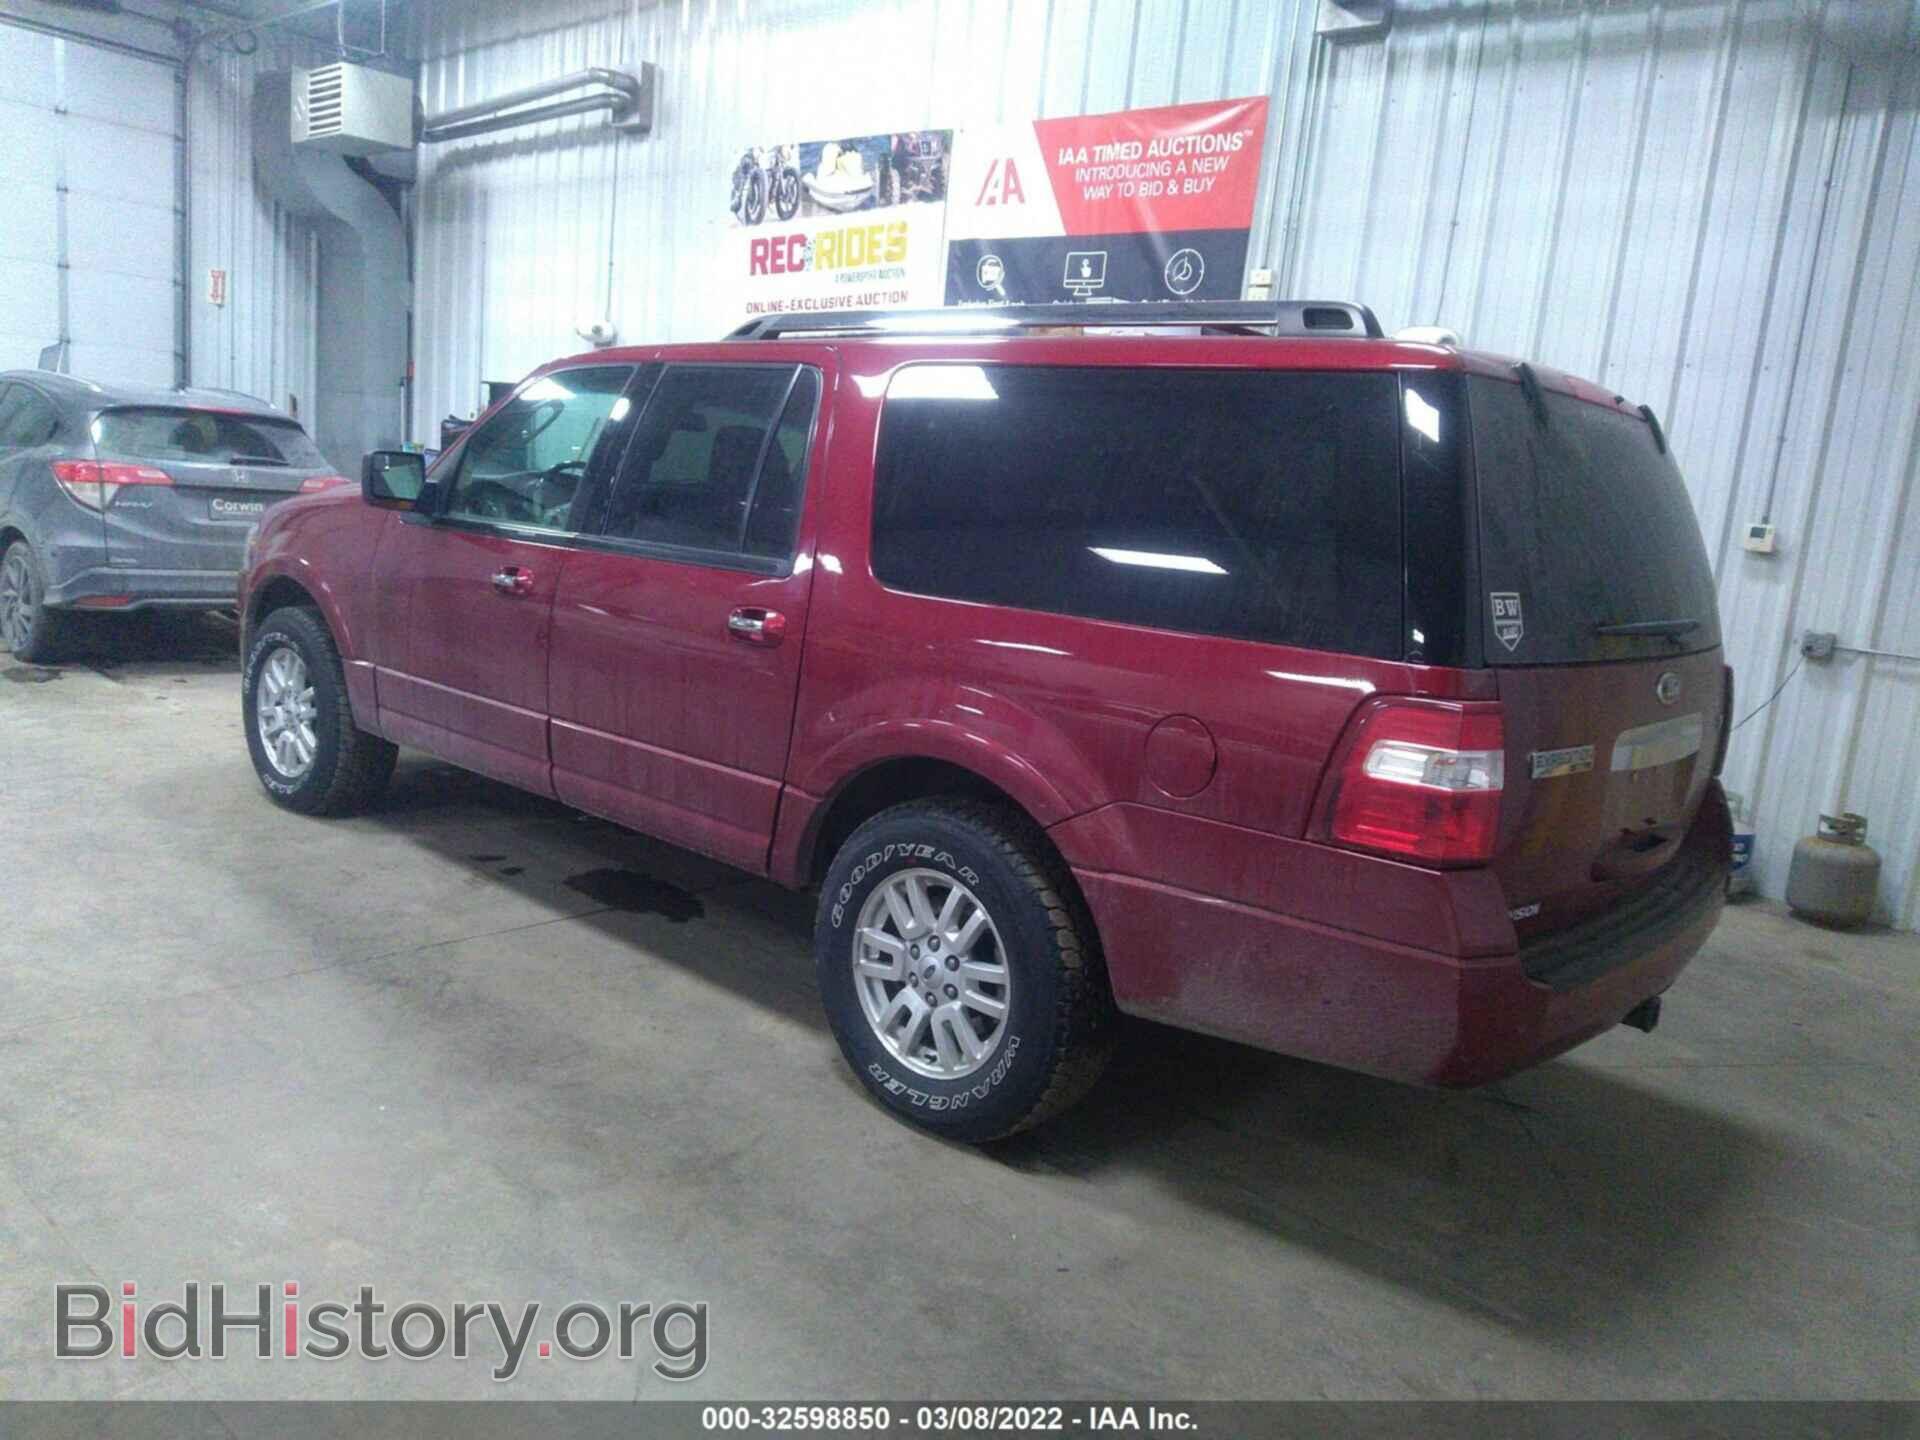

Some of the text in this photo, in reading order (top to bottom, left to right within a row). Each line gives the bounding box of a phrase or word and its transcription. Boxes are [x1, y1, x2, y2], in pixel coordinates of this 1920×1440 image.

[1059, 147, 1088, 166] IAA
[1093, 141, 1142, 163] TIMED
[1075, 155, 1229, 183] INTRODUCING A NEW
[1083, 176, 1216, 201] WAY TO BID & BUY
[750, 233, 808, 276] REC
[815, 221, 908, 272] RIDES
[746, 289, 909, 315] ONLINE-EXCLUSIVE AUCTION
[212, 498, 264, 512] Corwin
[868, 1035, 1021, 1111] WRANGLER
